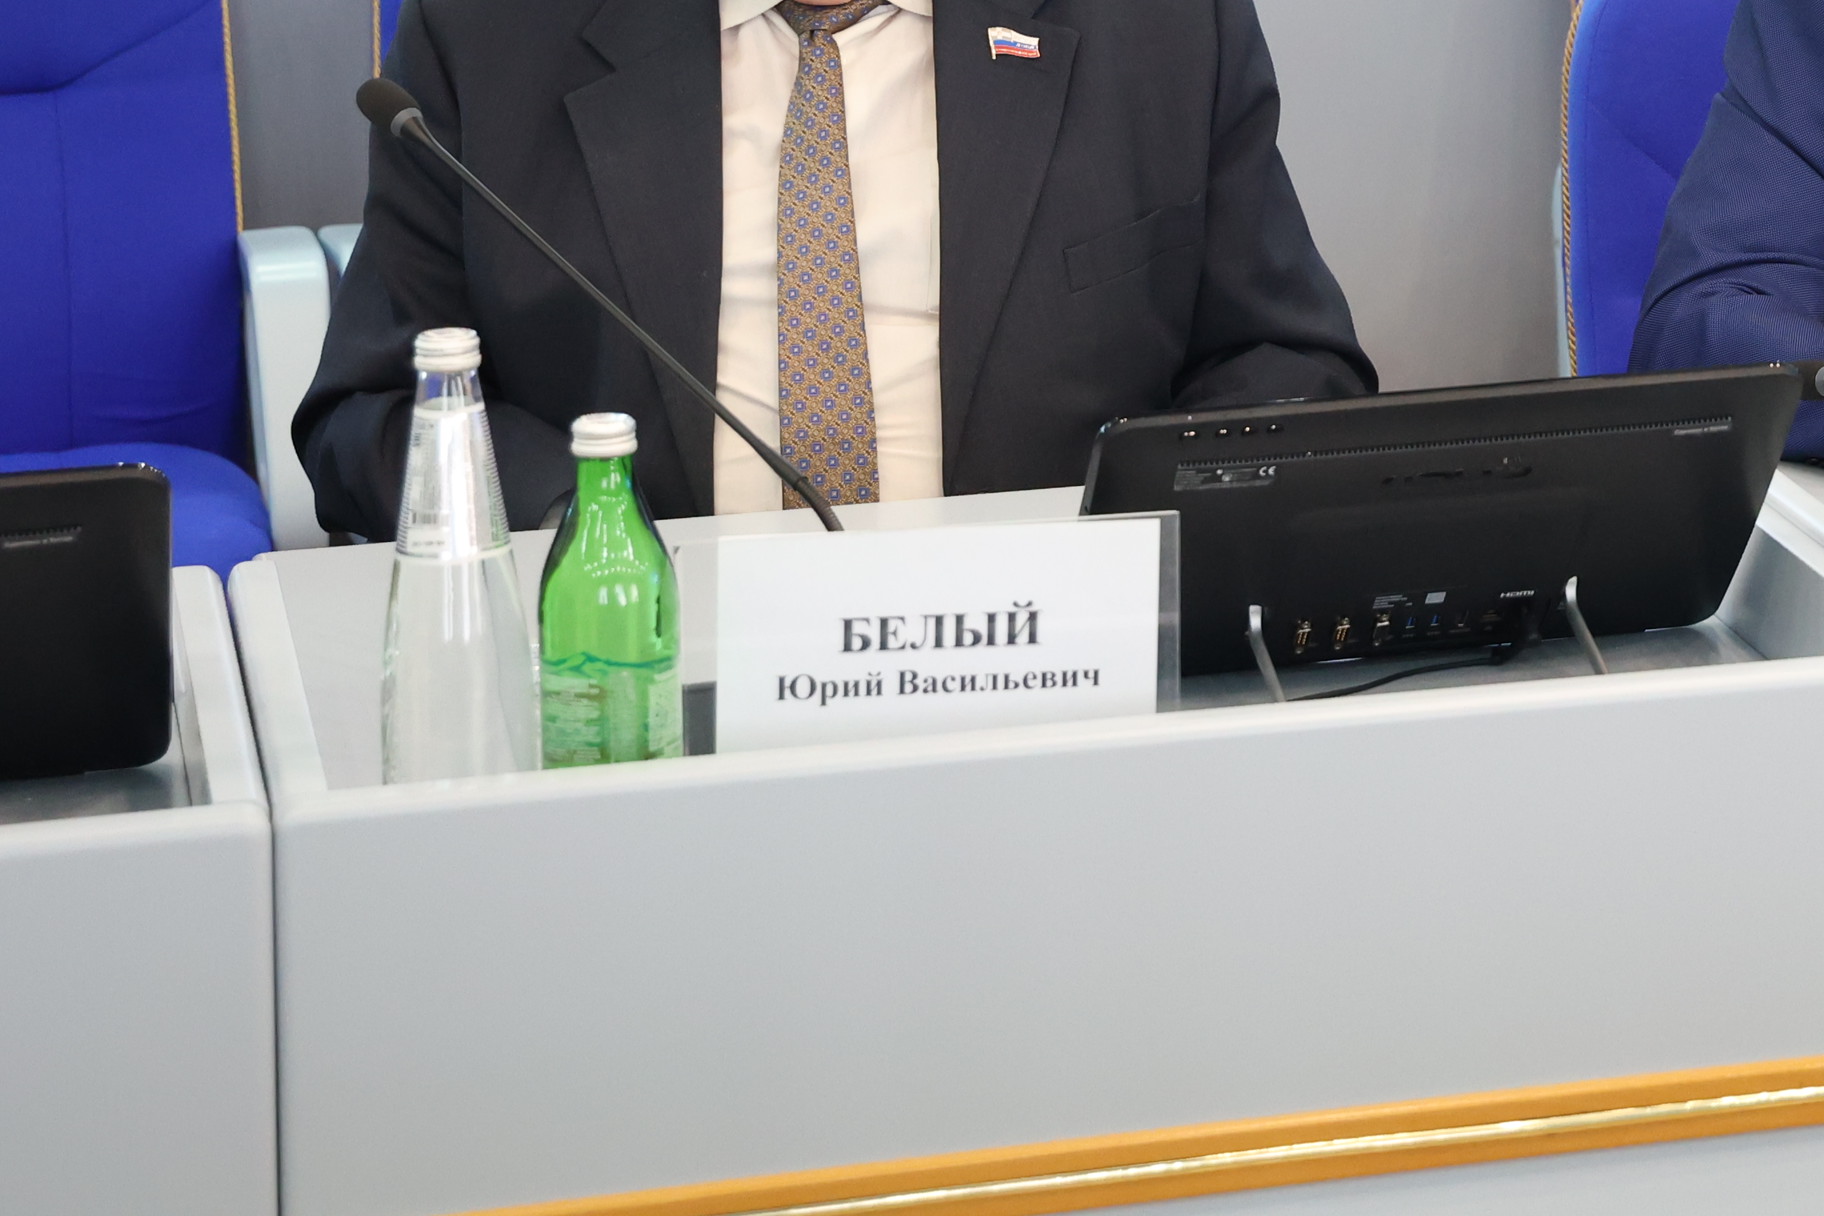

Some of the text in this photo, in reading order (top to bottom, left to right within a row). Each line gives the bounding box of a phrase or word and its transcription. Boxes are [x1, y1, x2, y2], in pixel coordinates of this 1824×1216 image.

[841, 600, 1040, 653] БЕЛЫЙ
[776, 668, 1102, 706] Юрий Васильевич
